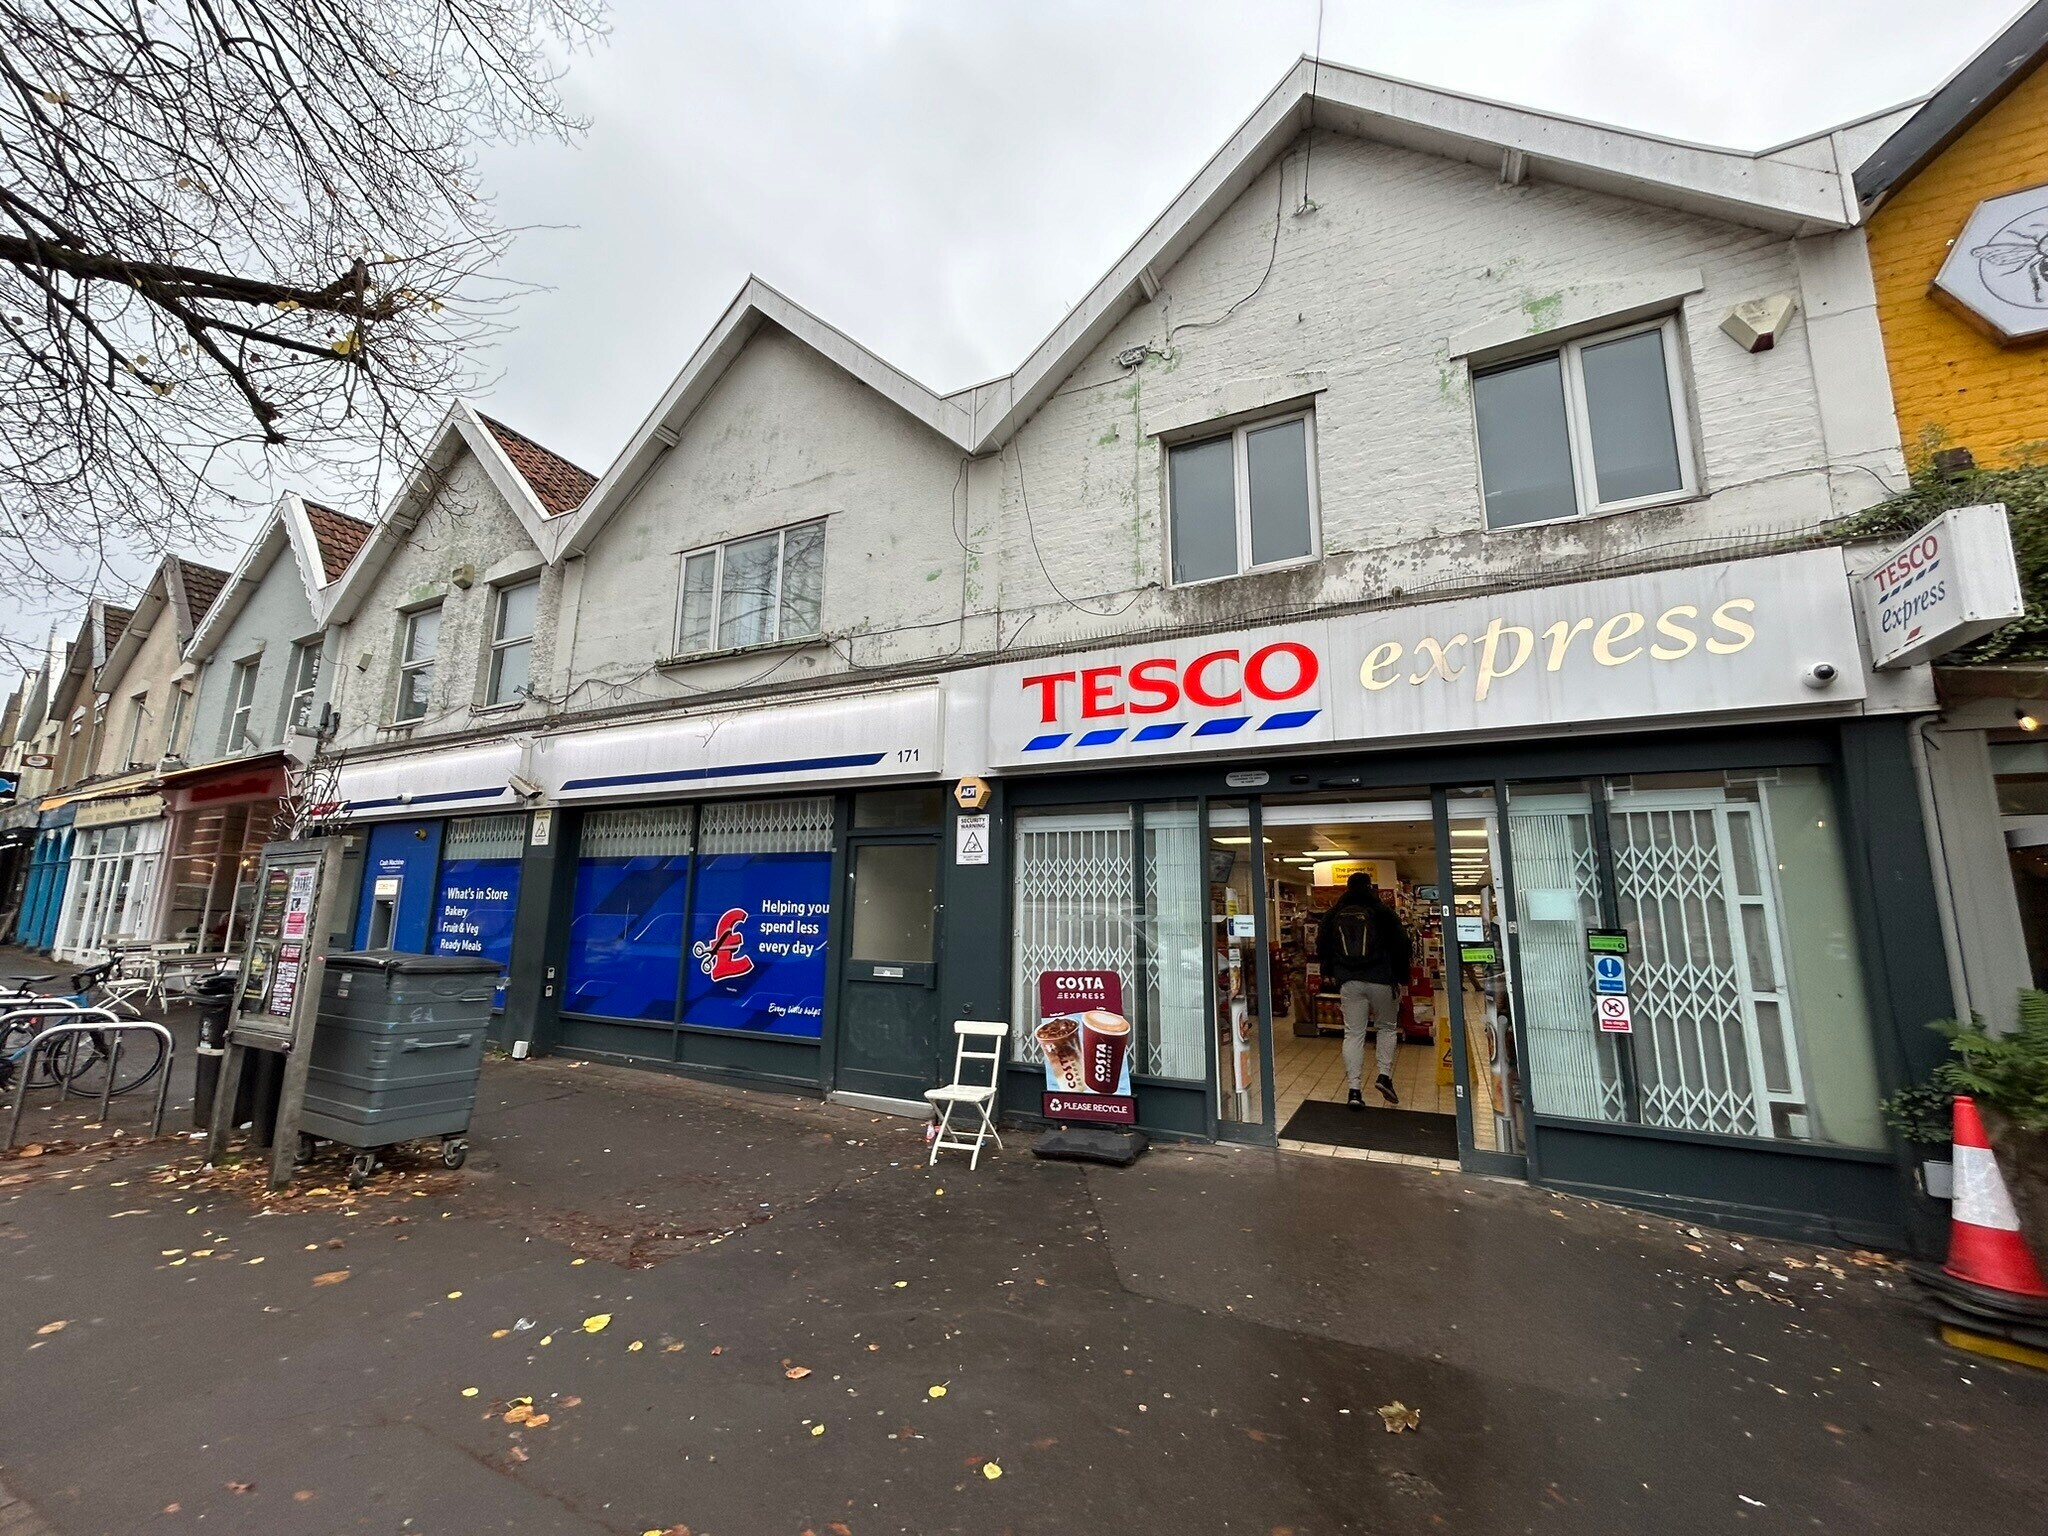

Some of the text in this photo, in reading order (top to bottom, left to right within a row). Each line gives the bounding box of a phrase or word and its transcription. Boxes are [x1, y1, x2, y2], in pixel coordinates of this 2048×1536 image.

[1874, 535, 1938, 592] TESCO
[1882, 580, 1946, 633] express
[1022, 598, 1755, 723] TESCO express
[897, 749, 919, 762] 171
[961, 787, 976, 797] ADT
[447, 887, 508, 900] What's in Store
[445, 906, 468, 918] Bakery
[762, 900, 830, 916] Helping you
[442, 922, 479, 936] Fruit & Veg
[760, 920, 819, 935] spend less
[440, 939, 482, 952] Ready Meals
[759, 941, 814, 957] every day
[1055, 976, 1105, 991] COSTA
[1064, 992, 1106, 1000] EXPRESS
[1094, 1043, 1107, 1083] COSTA
[1063, 1101, 1129, 1114] PLEASE RECYCLE
